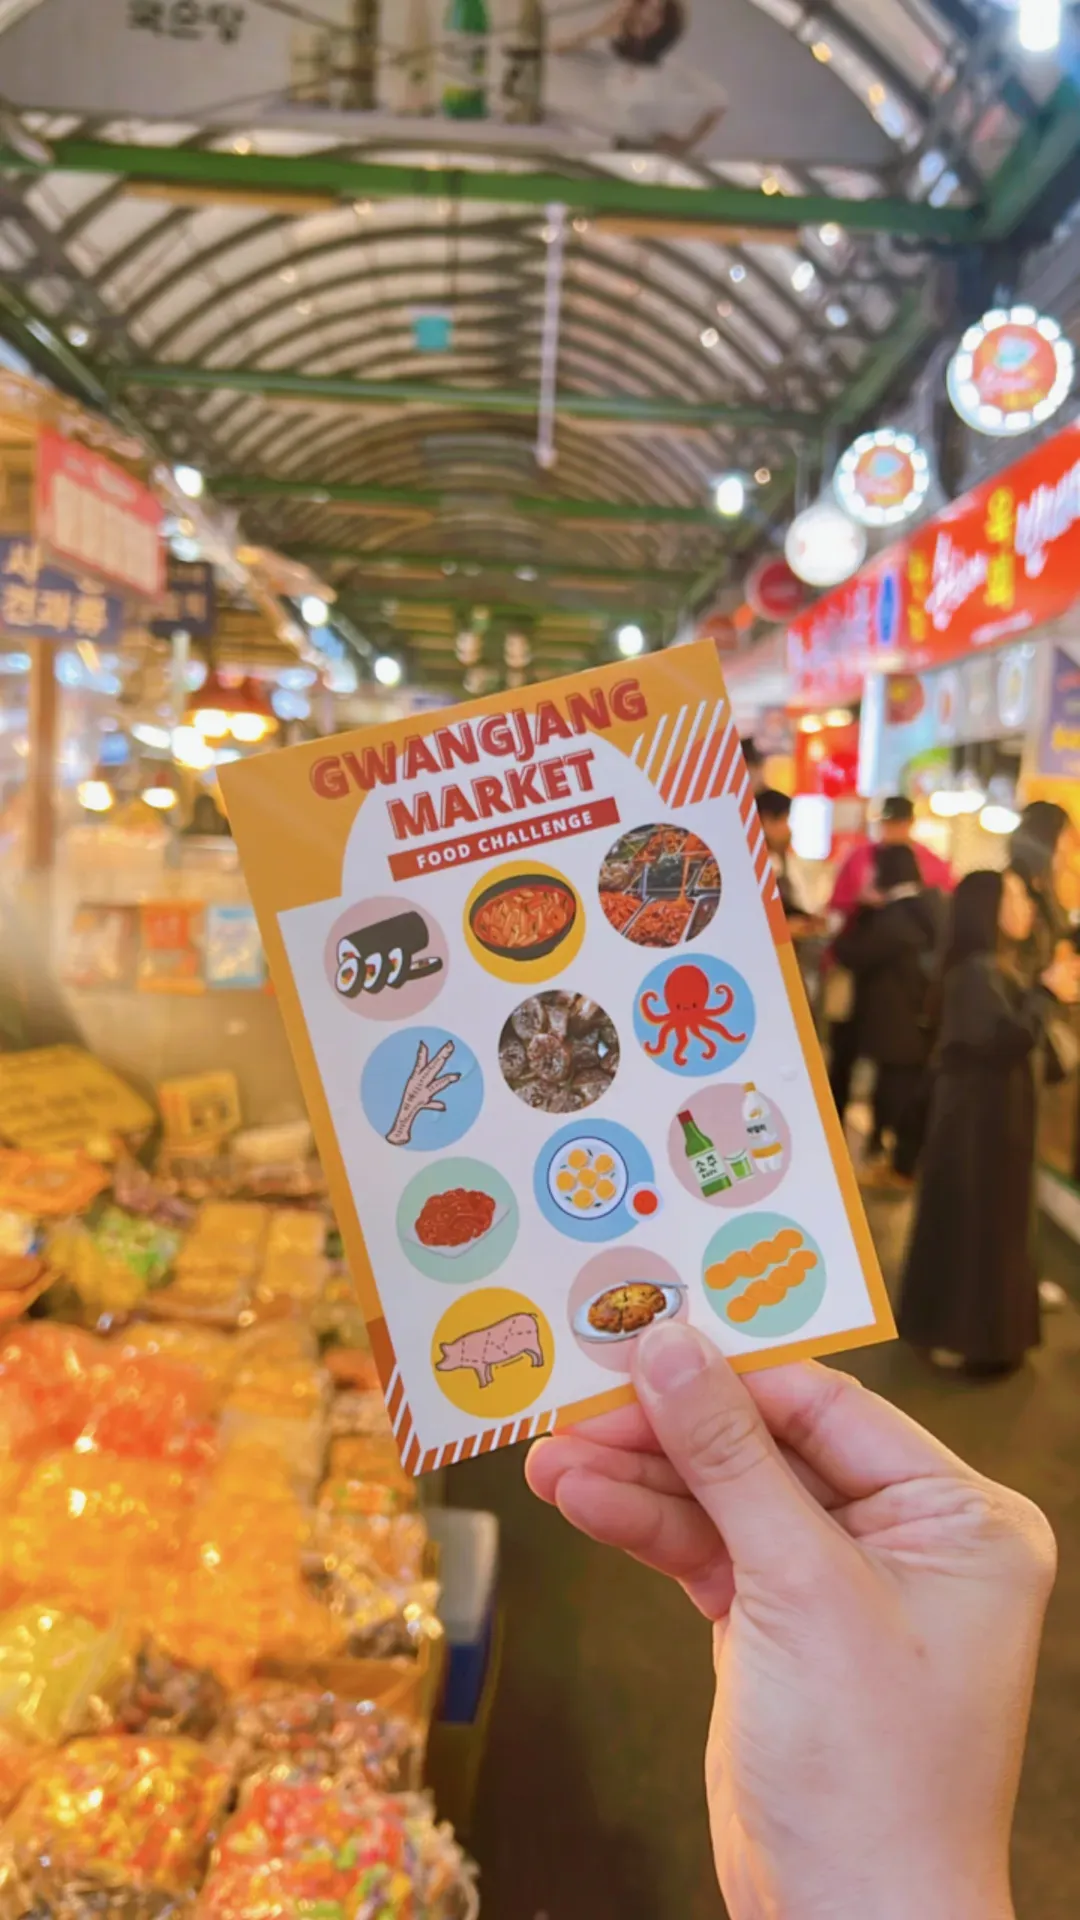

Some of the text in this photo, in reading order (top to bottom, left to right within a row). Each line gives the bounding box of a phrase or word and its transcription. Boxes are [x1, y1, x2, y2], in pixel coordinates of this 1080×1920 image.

[310, 679, 647, 799] GWANGJANG
[386, 749, 594, 840] MARKET
[416, 810, 593, 869] FOOD CHALLENGE
